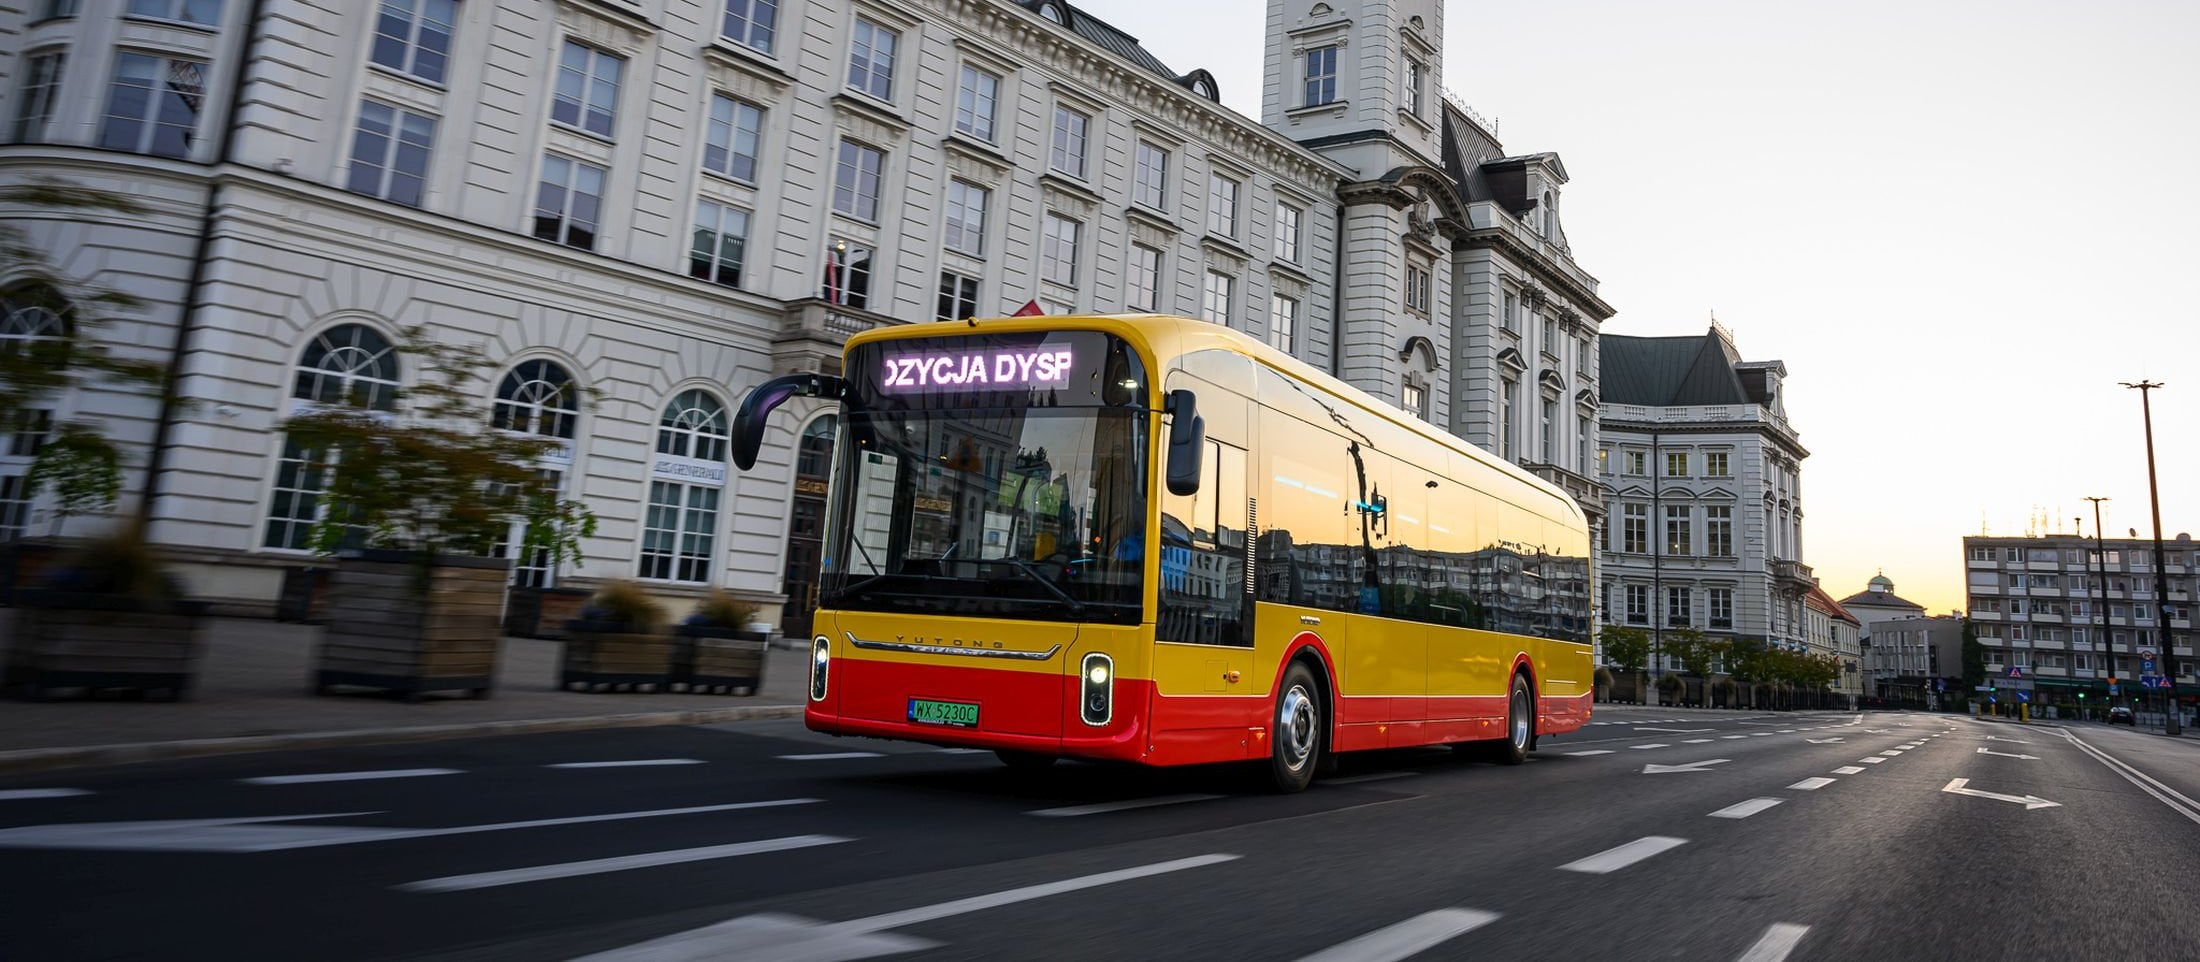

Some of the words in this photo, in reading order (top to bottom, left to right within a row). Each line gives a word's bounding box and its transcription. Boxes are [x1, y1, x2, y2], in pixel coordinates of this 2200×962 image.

[994, 351, 1072, 383] DYSP
[896, 635, 1003, 649] YUTONG
[916, 702, 932, 718] WX
[936, 704, 975, 722] 5230C
